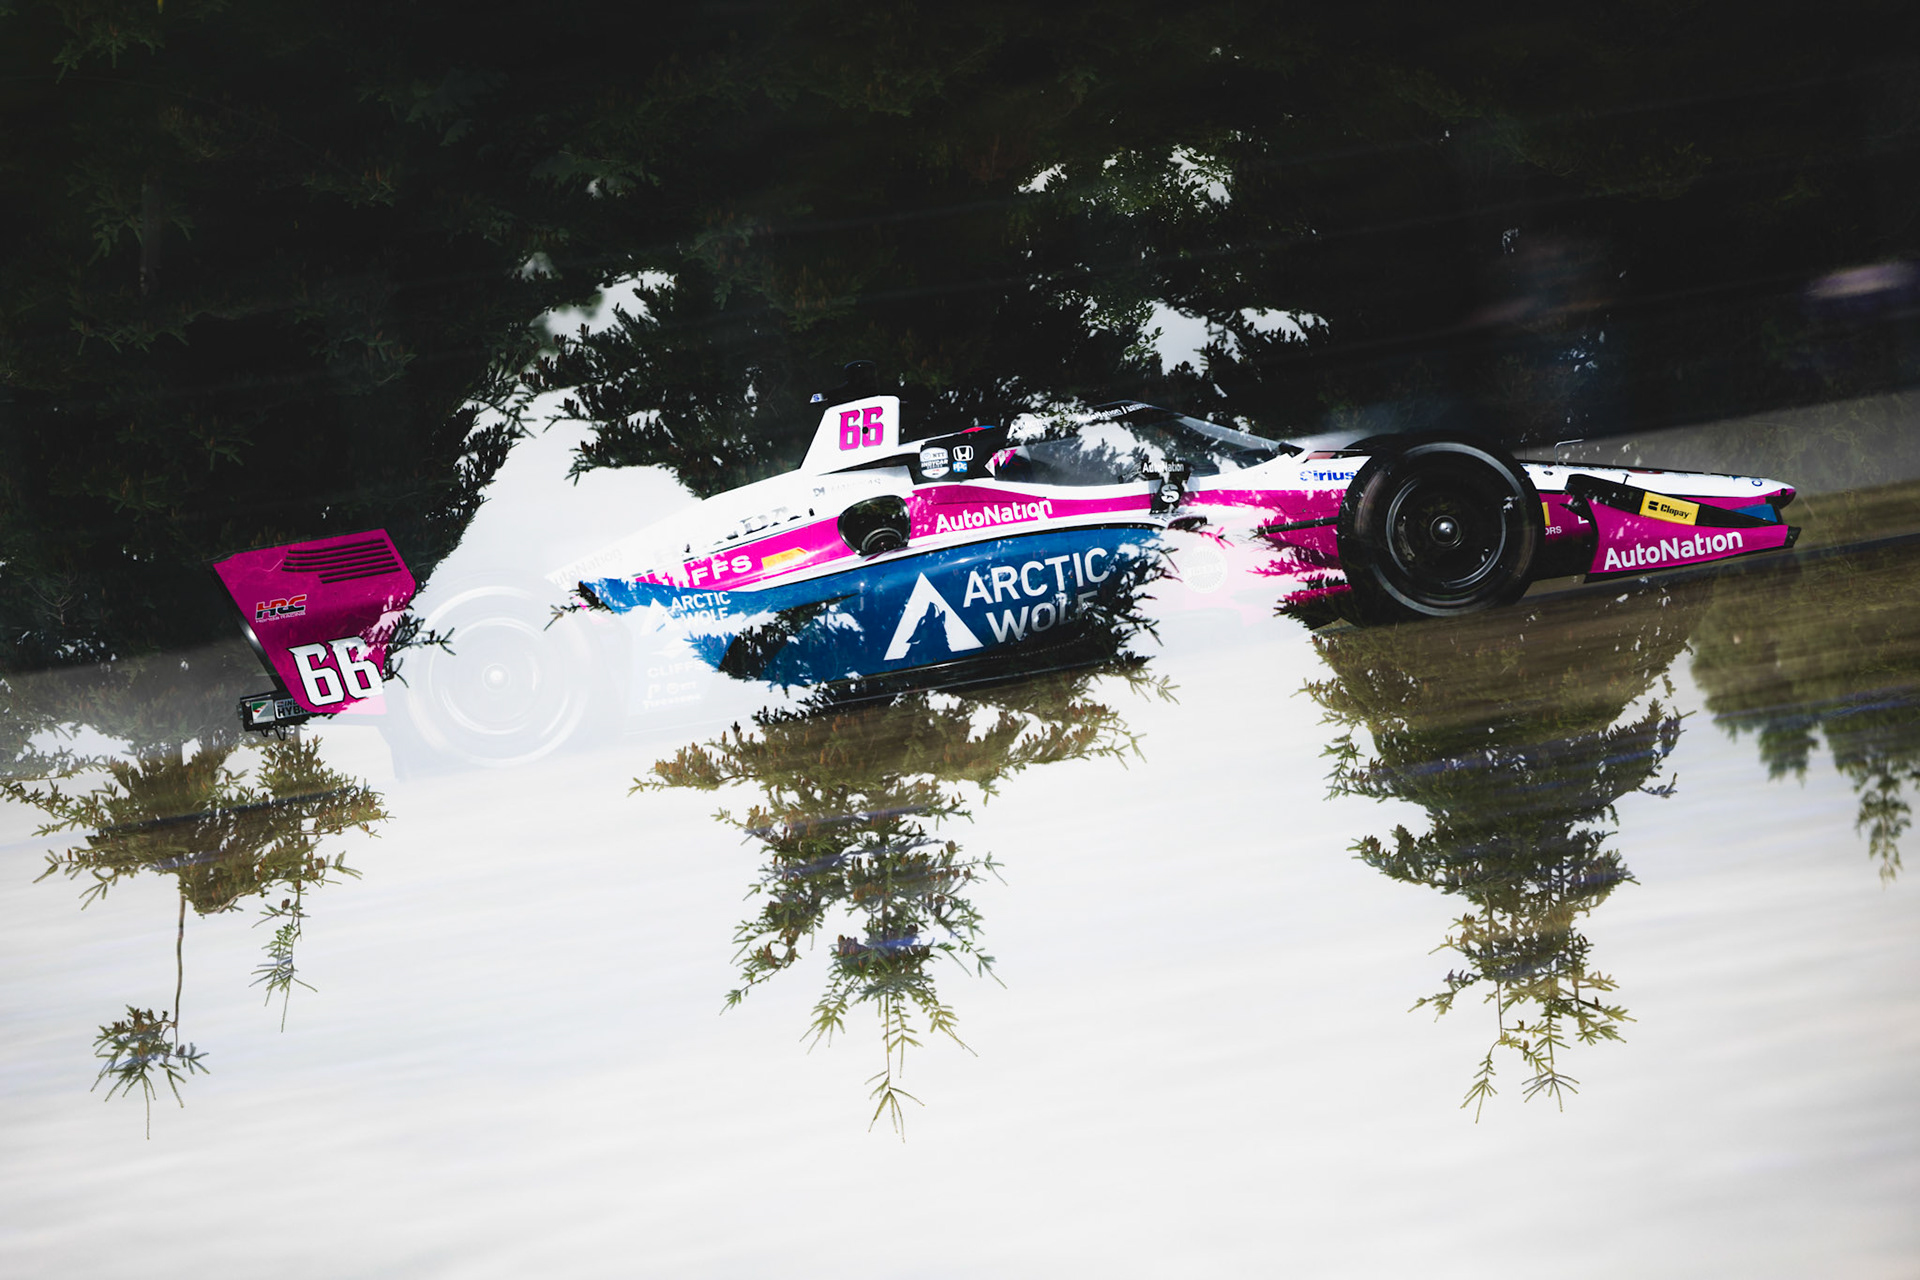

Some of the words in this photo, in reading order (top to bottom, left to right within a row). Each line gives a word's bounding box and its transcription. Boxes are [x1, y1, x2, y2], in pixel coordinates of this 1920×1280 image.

[839, 406, 884, 451] 66
[1142, 461, 1185, 473] AuNation
[1299, 470, 1359, 481] Sirius
[936, 500, 1053, 533] AutoNation
[1660, 503, 1690, 519] Clopay
[553, 548, 623, 586] utoNation
[1604, 531, 1744, 570] AutoNation
[963, 547, 1110, 608] ARCTIC
[256, 594, 307, 619] HRC
[671, 592, 732, 612] ARCTIC
[287, 636, 384, 706] 66
